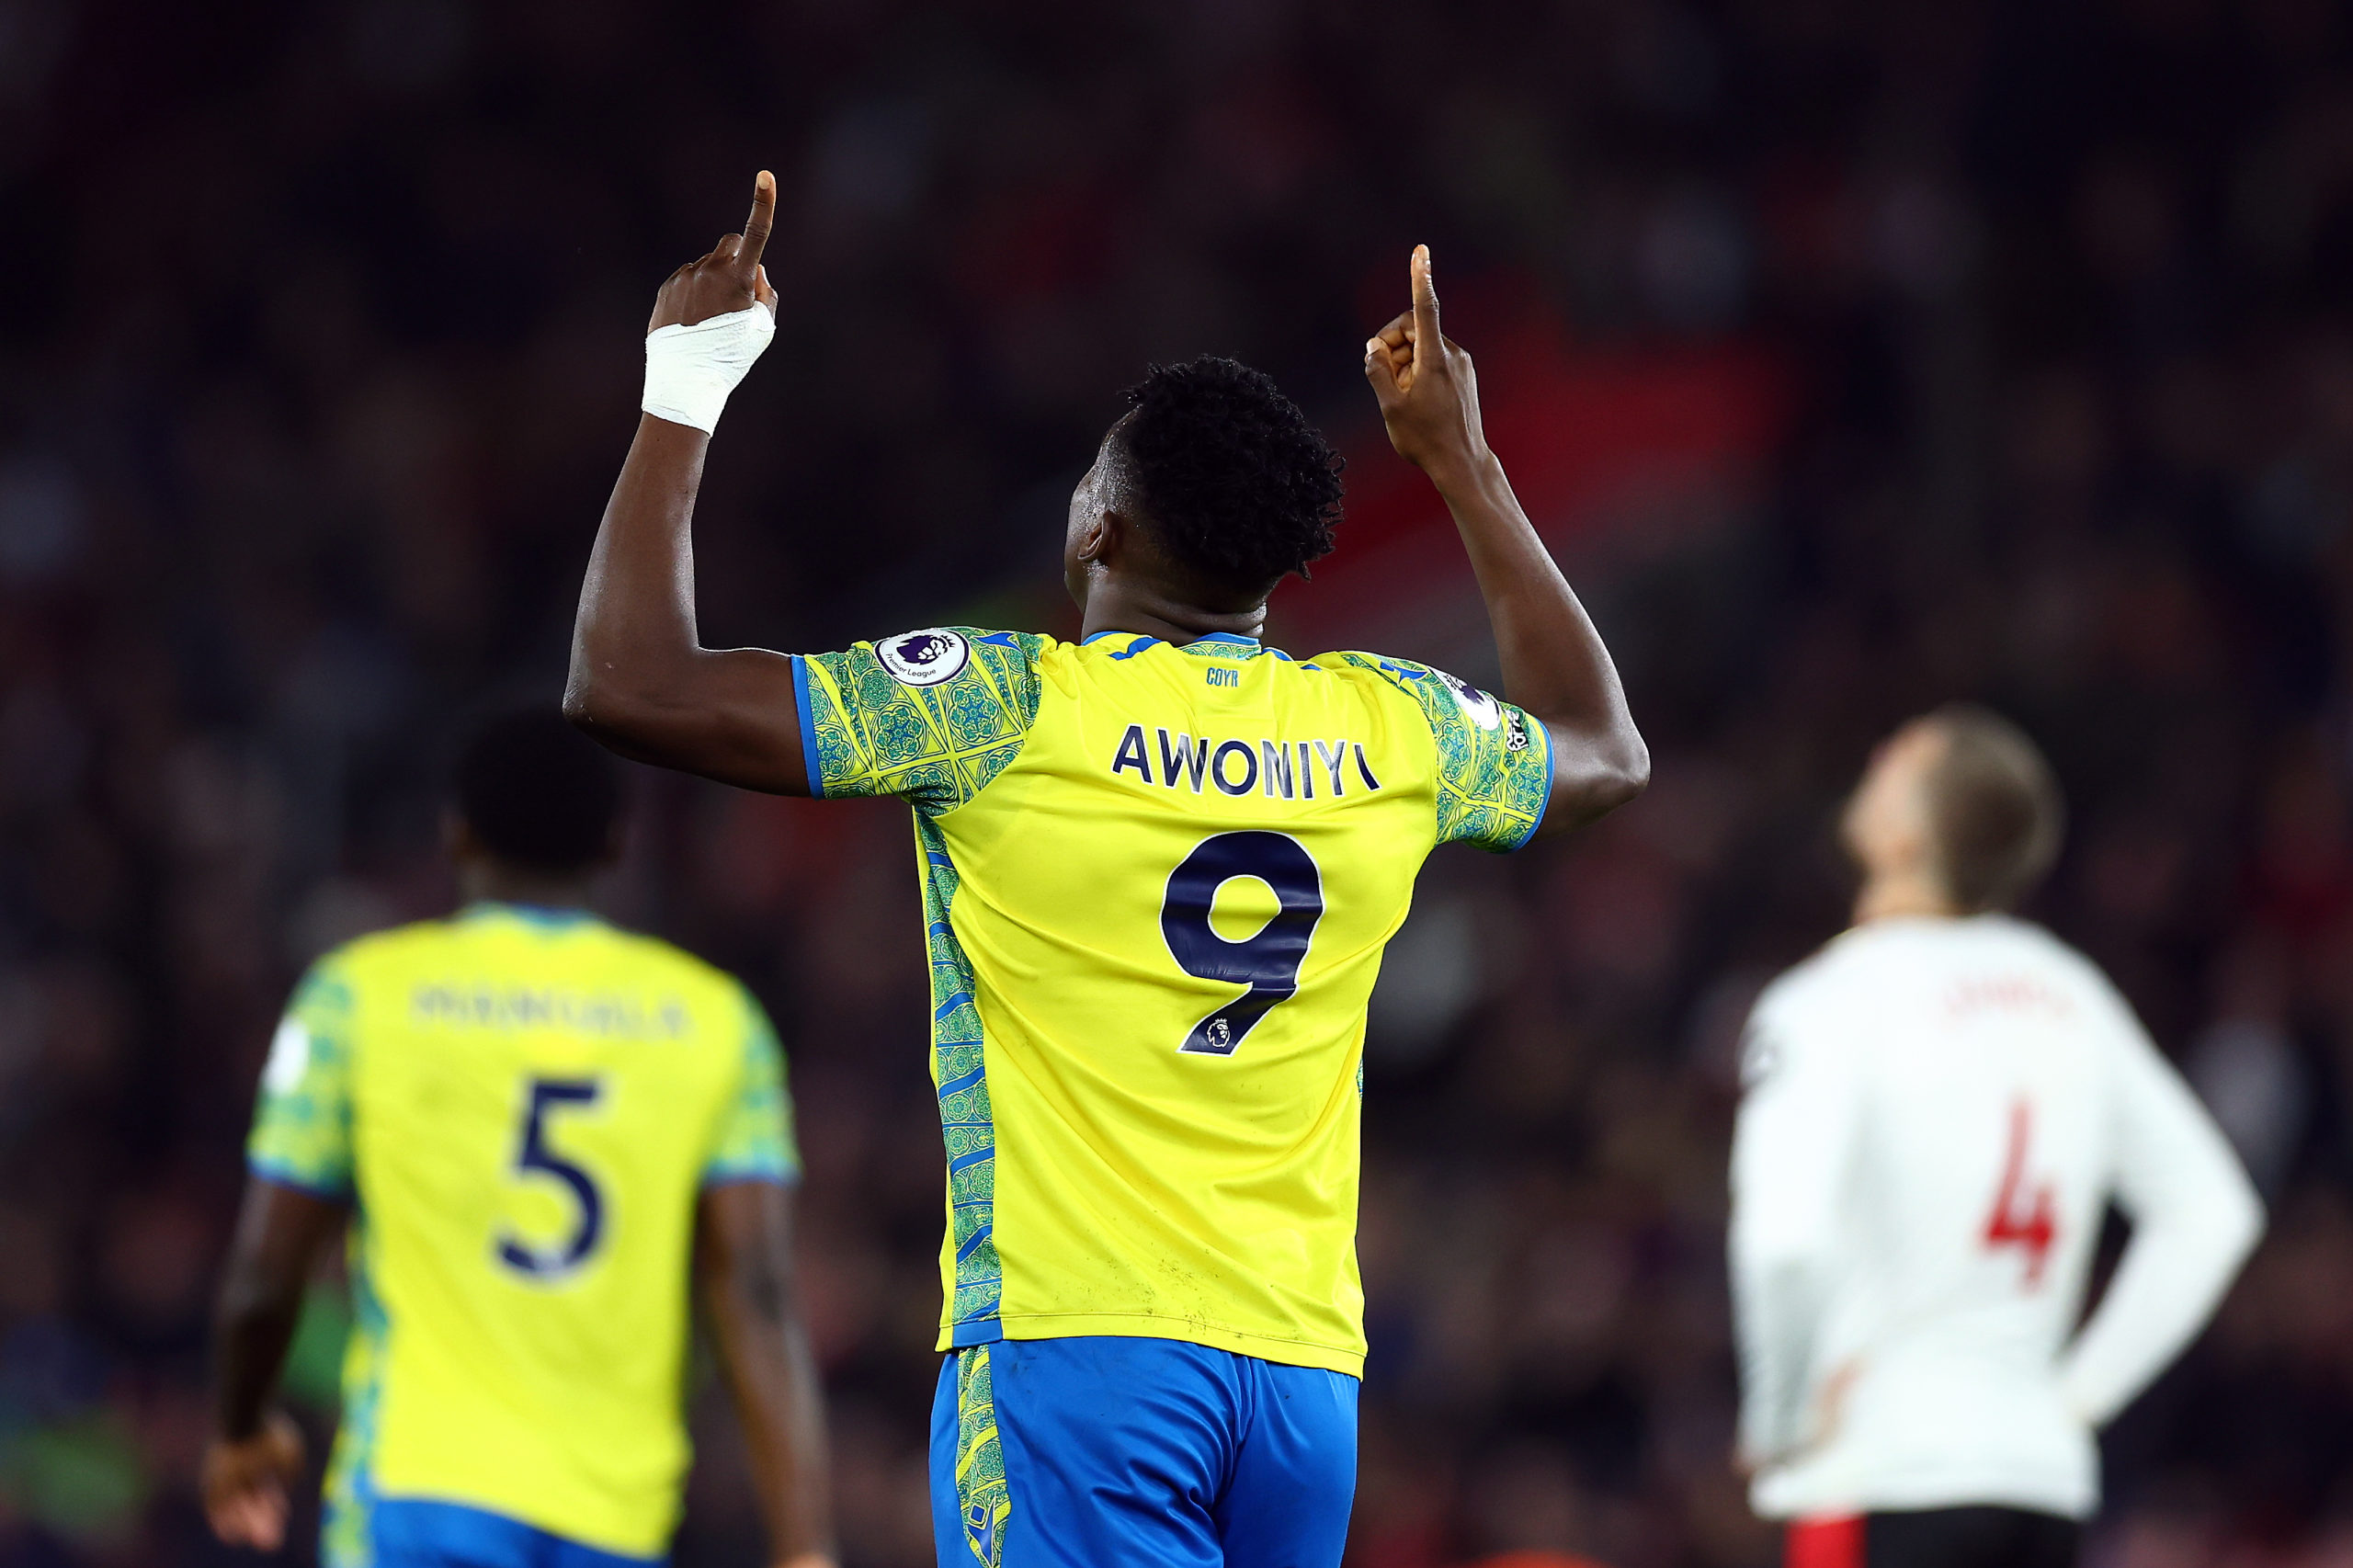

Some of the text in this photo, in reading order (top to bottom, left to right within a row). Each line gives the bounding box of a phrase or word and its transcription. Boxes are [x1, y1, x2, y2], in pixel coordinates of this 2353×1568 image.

[885, 653, 937, 678] Premier League
[1206, 666, 1239, 687] COYR
[1110, 722, 1382, 801] AWONIYI
[1159, 829, 1326, 1058] 9
[494, 1074, 607, 1282] 5
[1981, 1092, 2057, 1291] 4
